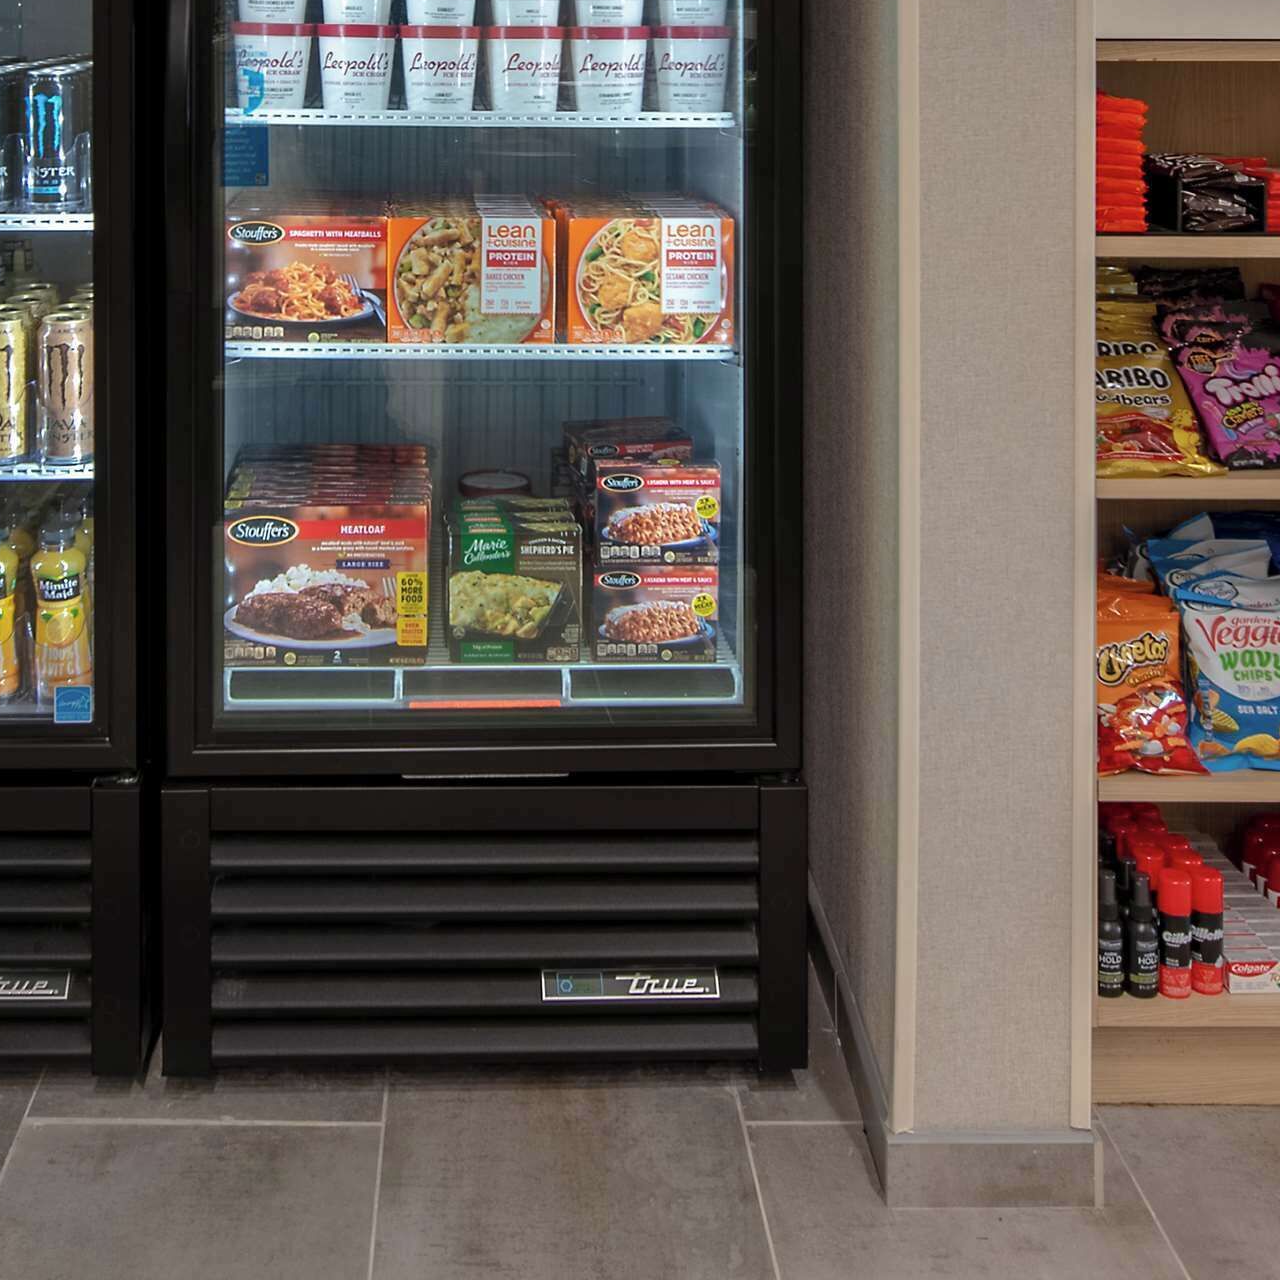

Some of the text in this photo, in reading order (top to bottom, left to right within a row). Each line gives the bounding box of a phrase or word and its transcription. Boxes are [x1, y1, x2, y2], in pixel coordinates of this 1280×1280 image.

[235, 225, 278, 241] Stouffer's
[344, 230, 381, 238] MEATBALLS
[488, 224, 536, 238] Lean
[667, 224, 715, 238] Lean
[489, 252, 534, 261] PROTEIN
[668, 252, 714, 261] PROTEIN
[1096, 369, 1169, 389] ARIBO
[1097, 392, 1170, 406] odbears
[606, 478, 639, 488] Stouffer's
[236, 522, 291, 540] Stouffer's
[341, 525, 386, 535] MEATLOAF
[464, 539, 509, 553] Marie
[520, 545, 575, 555] SHEPHERD'S PIE
[603, 575, 636, 586] Stouffer's
[401, 595, 423, 603] FOOD
[1234, 670, 1272, 682] CHIPS
[1238, 705, 1278, 715] SEA SALT
[1231, 963, 1270, 973] Colgate
